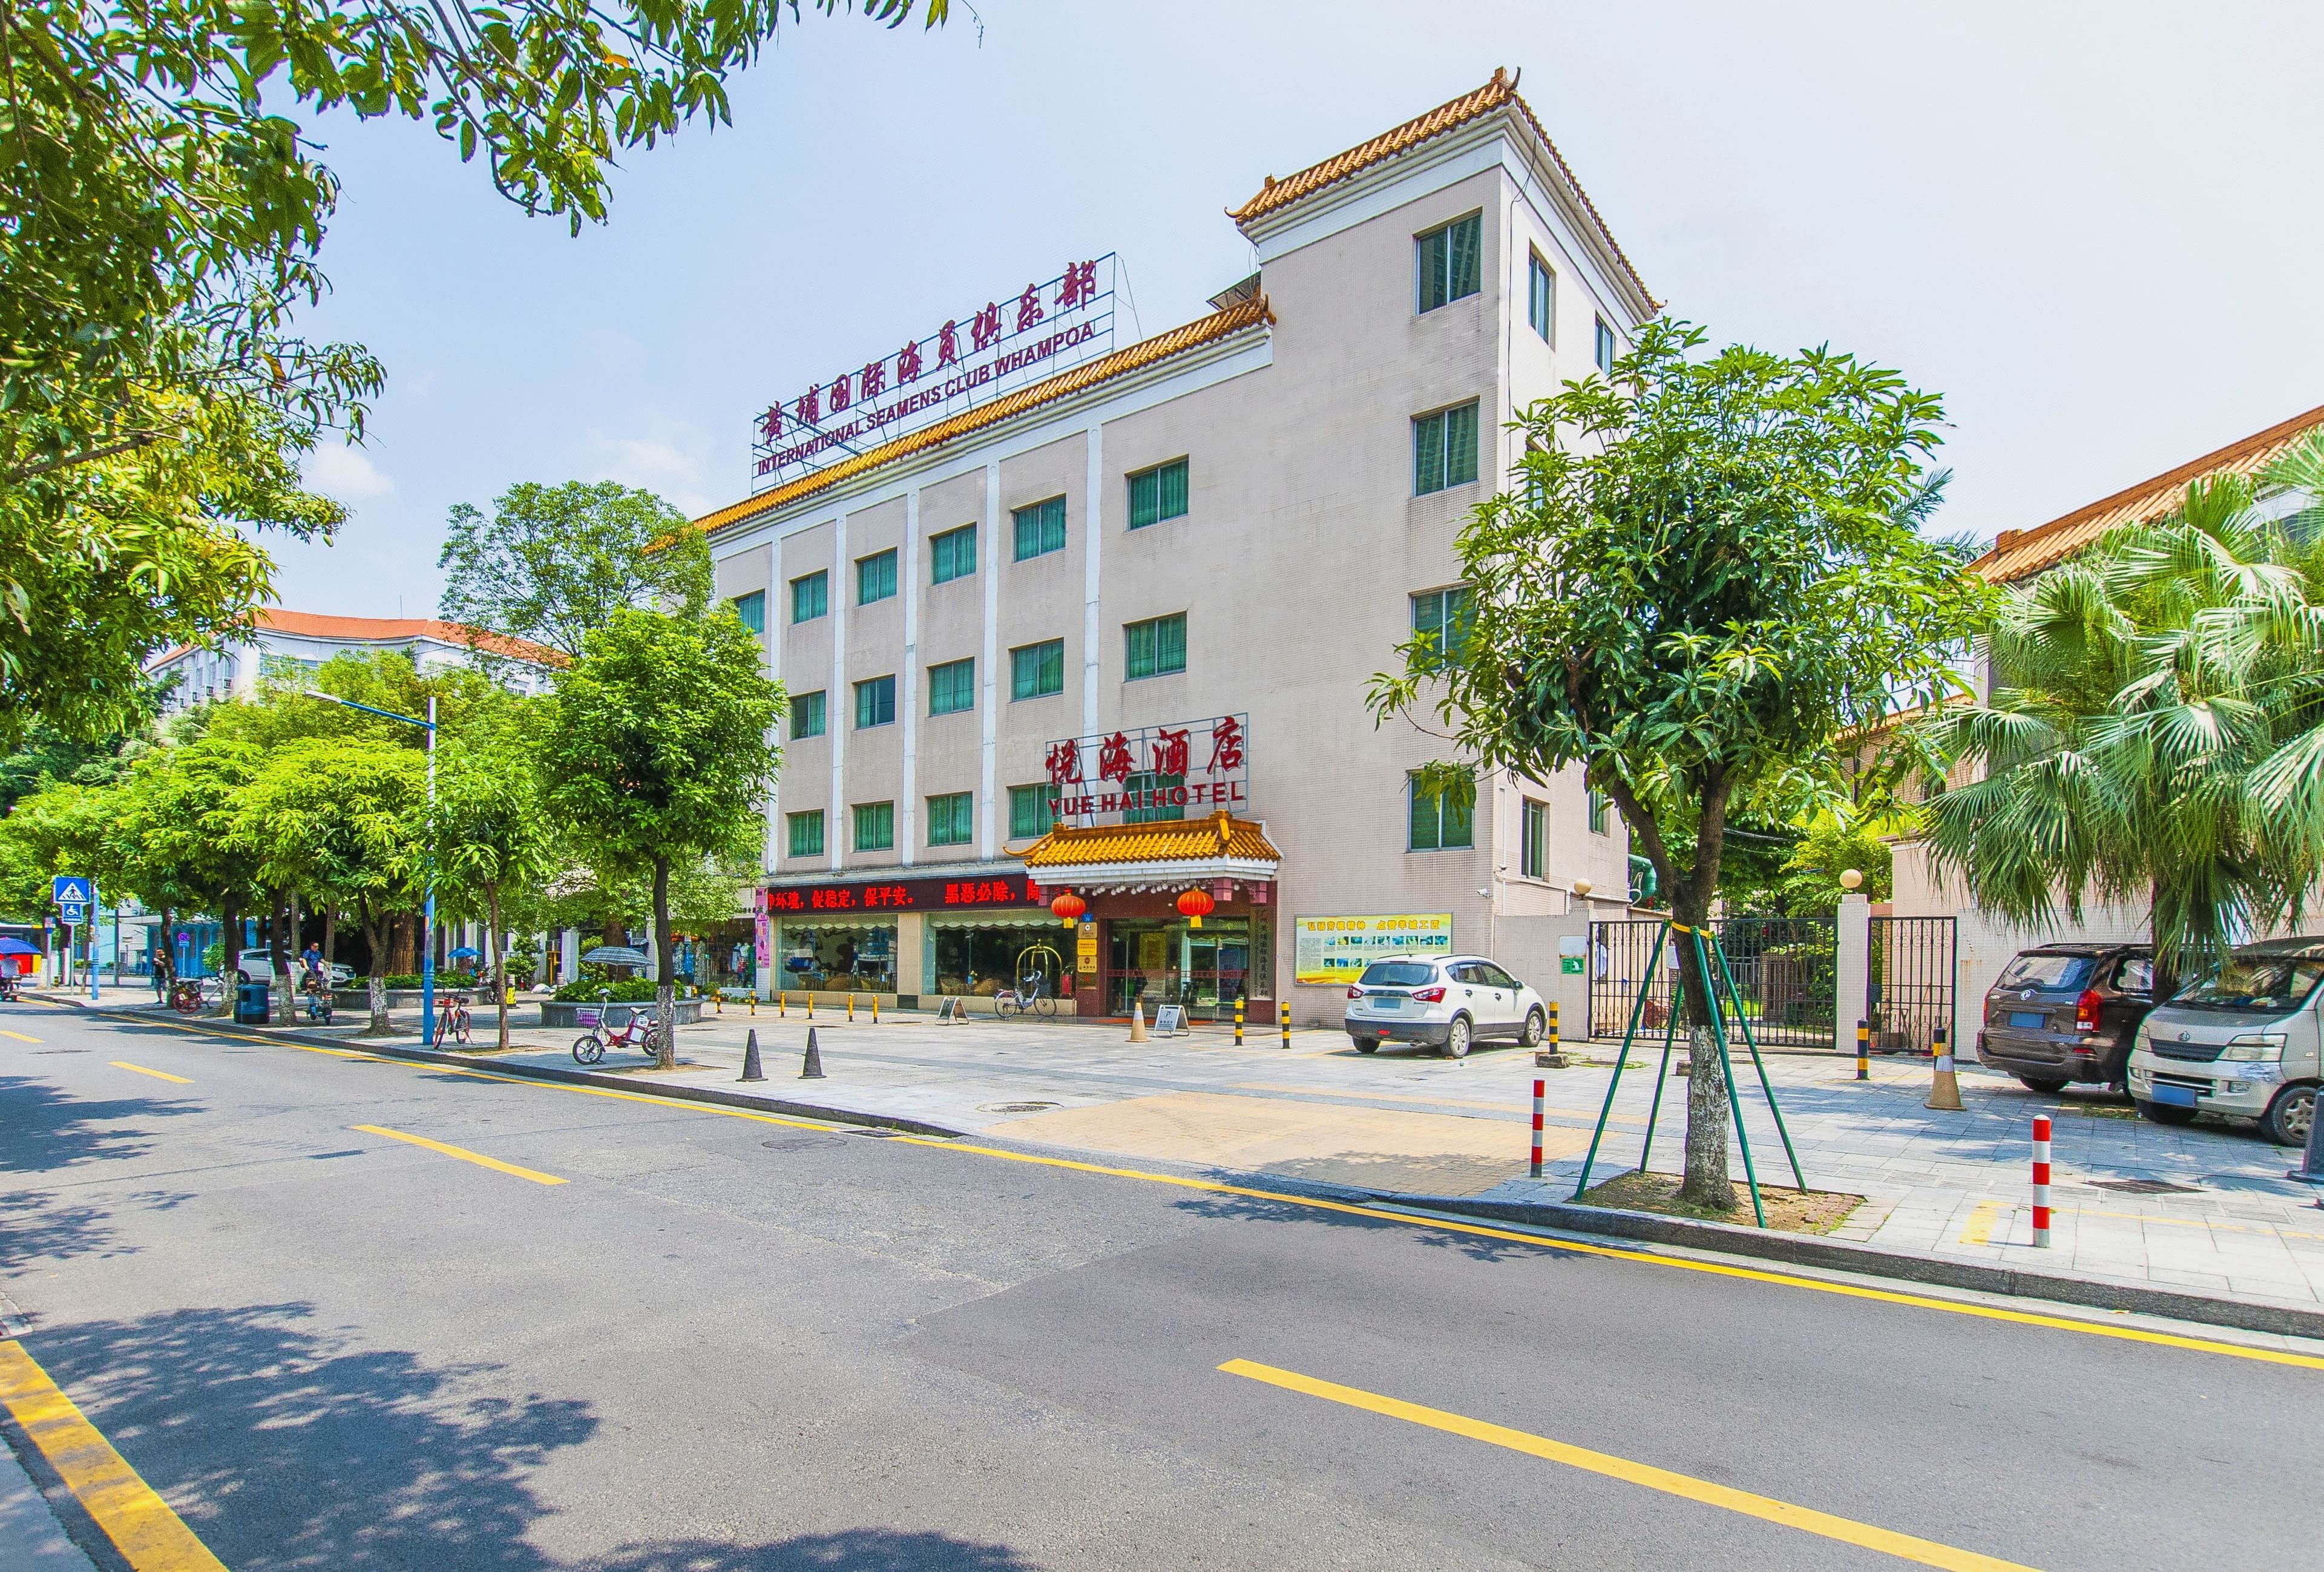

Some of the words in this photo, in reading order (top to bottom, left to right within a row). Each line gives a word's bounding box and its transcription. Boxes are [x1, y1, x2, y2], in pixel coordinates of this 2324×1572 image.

[758, 419, 863, 475] INTERNATIONAL
[867, 386, 940, 430] SEAMENS
[945, 364, 990, 396] CLUB
[994, 321, 1094, 376] WHAMPOA
[760, 260, 1095, 447] 黄埔国际海员俱乐部
[1046, 715, 1244, 786] 悦海酒店
[1048, 795, 1094, 817] YUE
[1101, 790, 1143, 812] HAI
[1152, 781, 1244, 807] HOTEL
